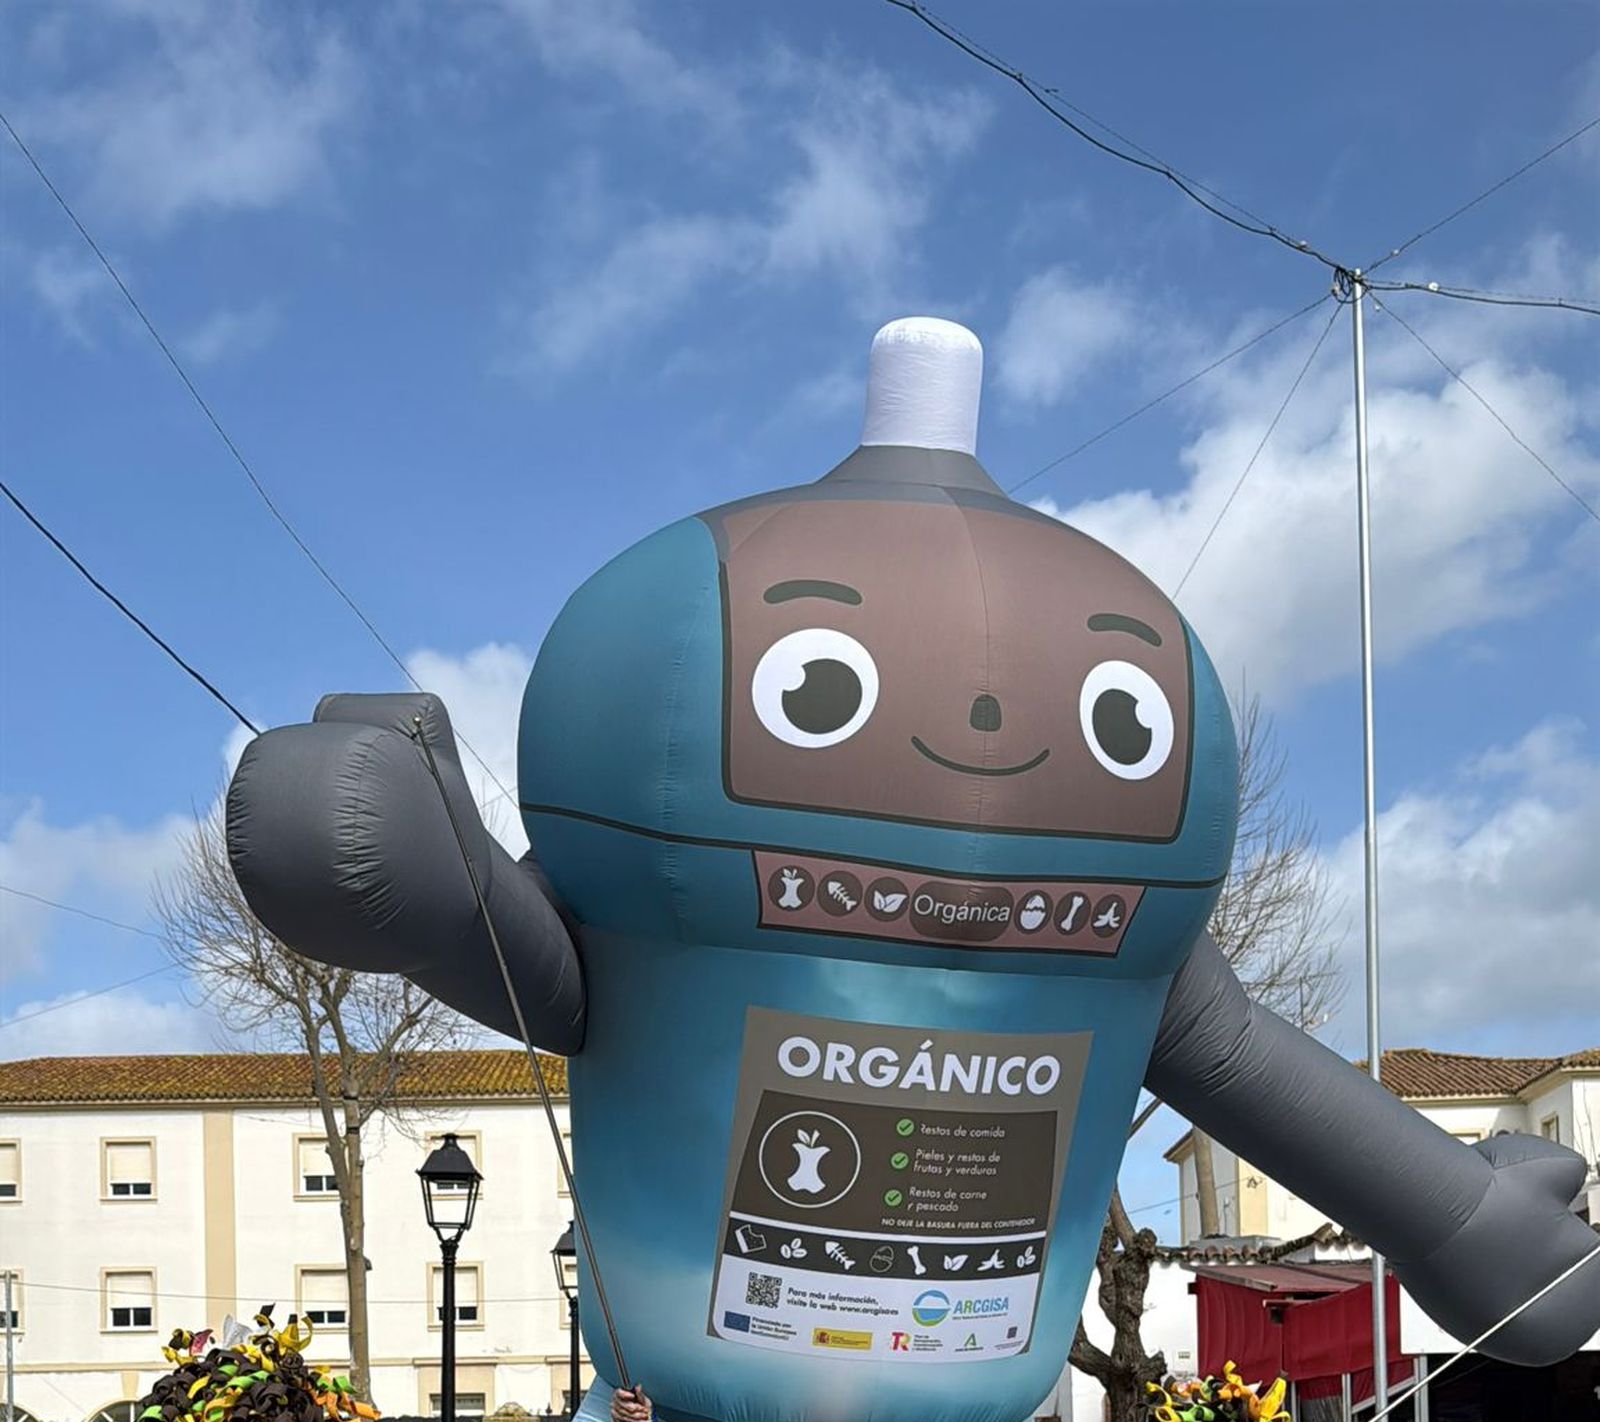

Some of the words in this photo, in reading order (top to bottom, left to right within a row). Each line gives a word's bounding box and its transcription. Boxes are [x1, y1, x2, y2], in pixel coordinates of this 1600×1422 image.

[914, 893, 1011, 924] Orgánica
[777, 1036, 1061, 1096] ORGÁNICO
[954, 1125, 967, 1137] de
[970, 1126, 1006, 1138] comida
[915, 1149, 945, 1161] Pieles
[948, 1154, 954, 1163] y
[957, 1152, 986, 1163] restos
[988, 1151, 1001, 1162] de
[913, 1161, 943, 1174] frutas
[945, 1166, 953, 1176] y
[955, 1164, 997, 1175] verduras
[909, 1186, 941, 1199] Restos
[944, 1188, 957, 1199] de
[959, 1191, 988, 1200] carne
[916, 1201, 959, 1212] pescado
[953, 1297, 1009, 1314] ARCGISA
